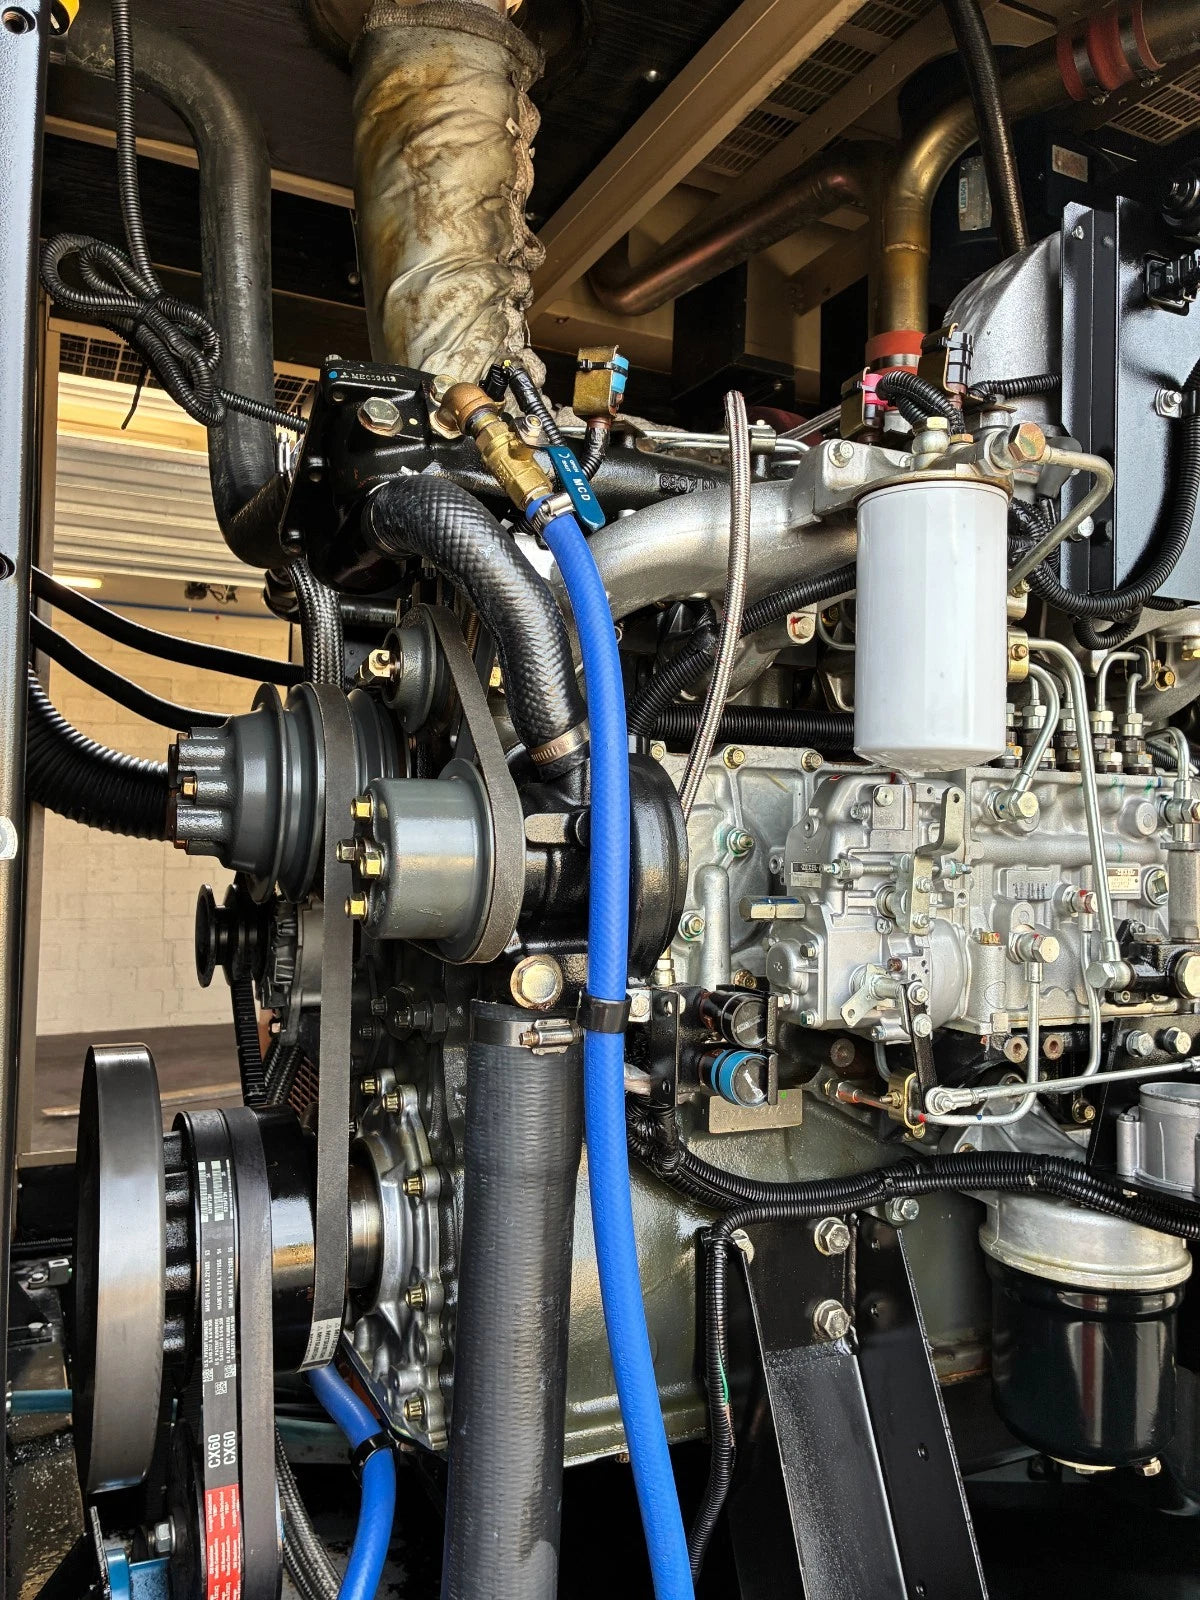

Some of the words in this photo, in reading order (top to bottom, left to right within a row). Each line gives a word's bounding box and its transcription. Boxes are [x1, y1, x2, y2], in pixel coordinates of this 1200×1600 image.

[562, 459, 571, 473] SHUT
[570, 459, 579, 473] OPEN
[572, 478, 591, 501] MCD
[208, 1433, 220, 1468] CX60
[223, 1430, 236, 1465] CX60
